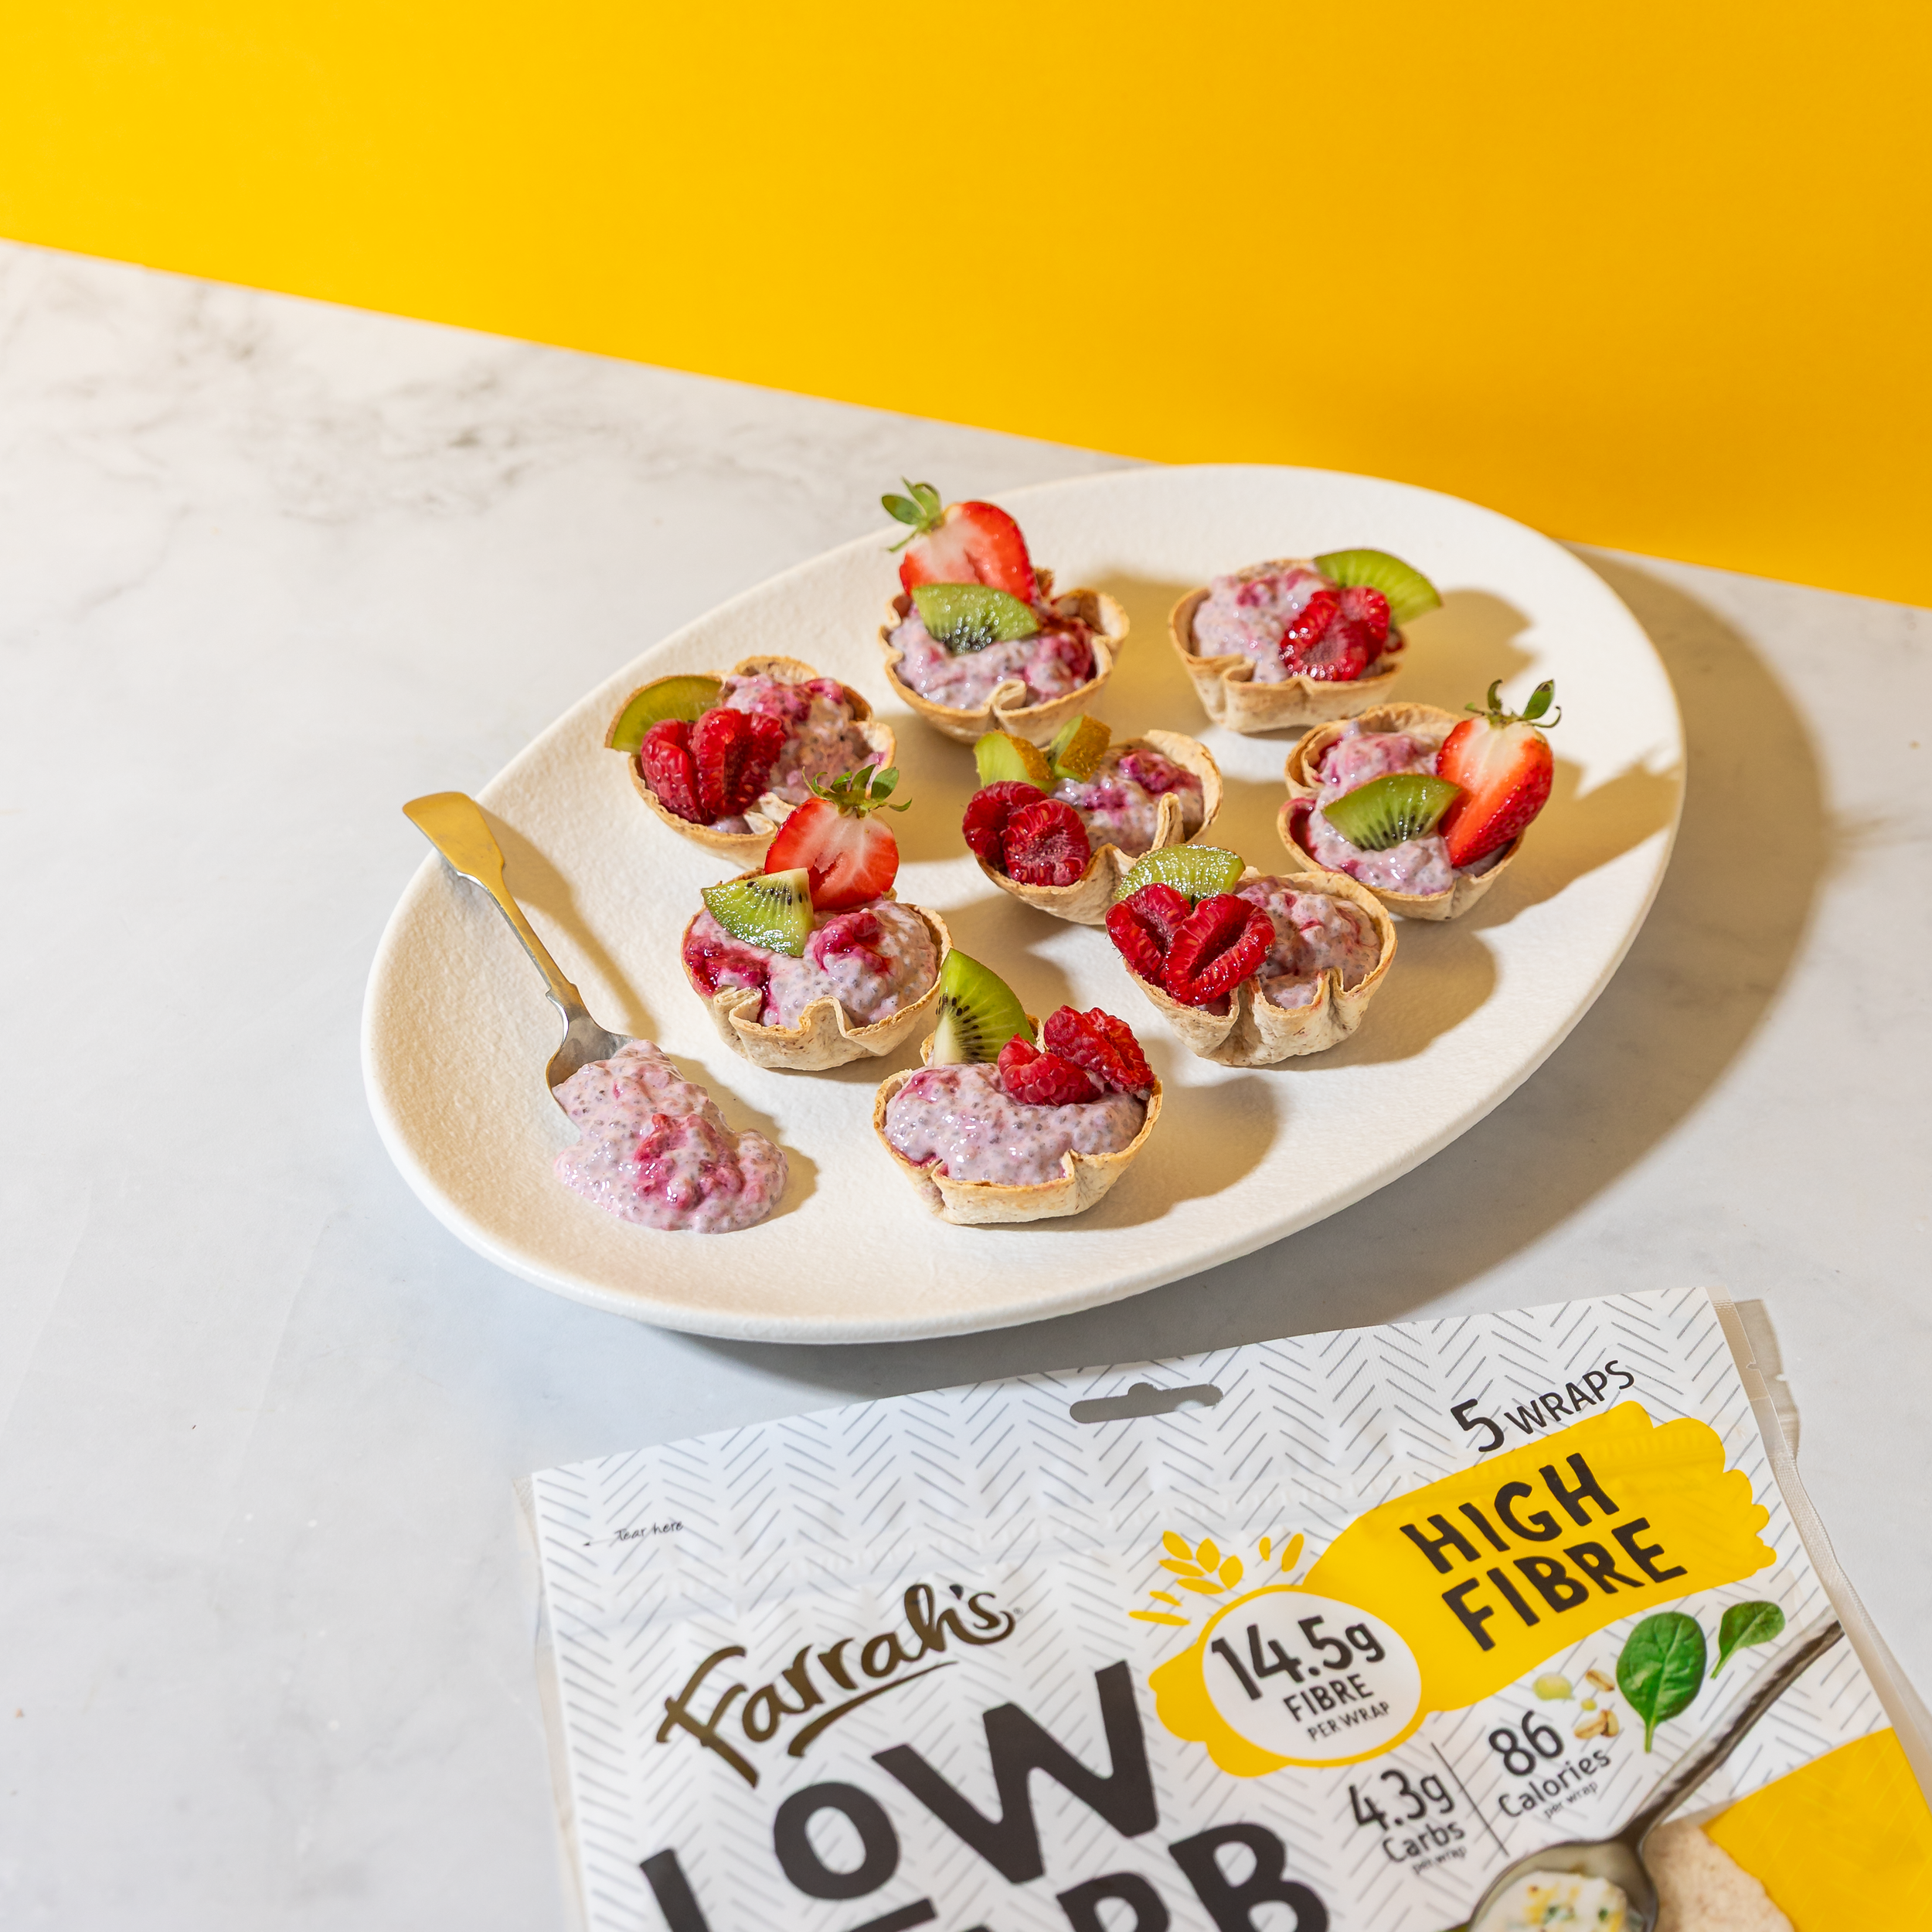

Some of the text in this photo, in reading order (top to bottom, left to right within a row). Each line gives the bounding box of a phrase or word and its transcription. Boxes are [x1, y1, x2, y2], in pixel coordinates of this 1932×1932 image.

[1451, 1359, 1635, 1453] 5 WRAPS
[614, 1521, 684, 1541] Tear here
[1400, 1452, 1620, 1574] HIGH
[1442, 1517, 1688, 1651] FIBRE
[655, 1583, 1016, 1788] Farrah's
[1211, 1614, 1386, 1701] 14.5g
[1283, 1673, 1374, 1723] FIBRE
[1307, 1700, 1389, 1741] PER WRAP
[1488, 1709, 1564, 1777] 86
[1349, 1768, 1455, 1832] 4.3g
[1498, 1750, 1611, 1817] Calories
[1544, 1781, 1598, 1818] per wrap
[1382, 1821, 1465, 1862] Carbs
[1413, 1846, 1467, 1876] per wrap
